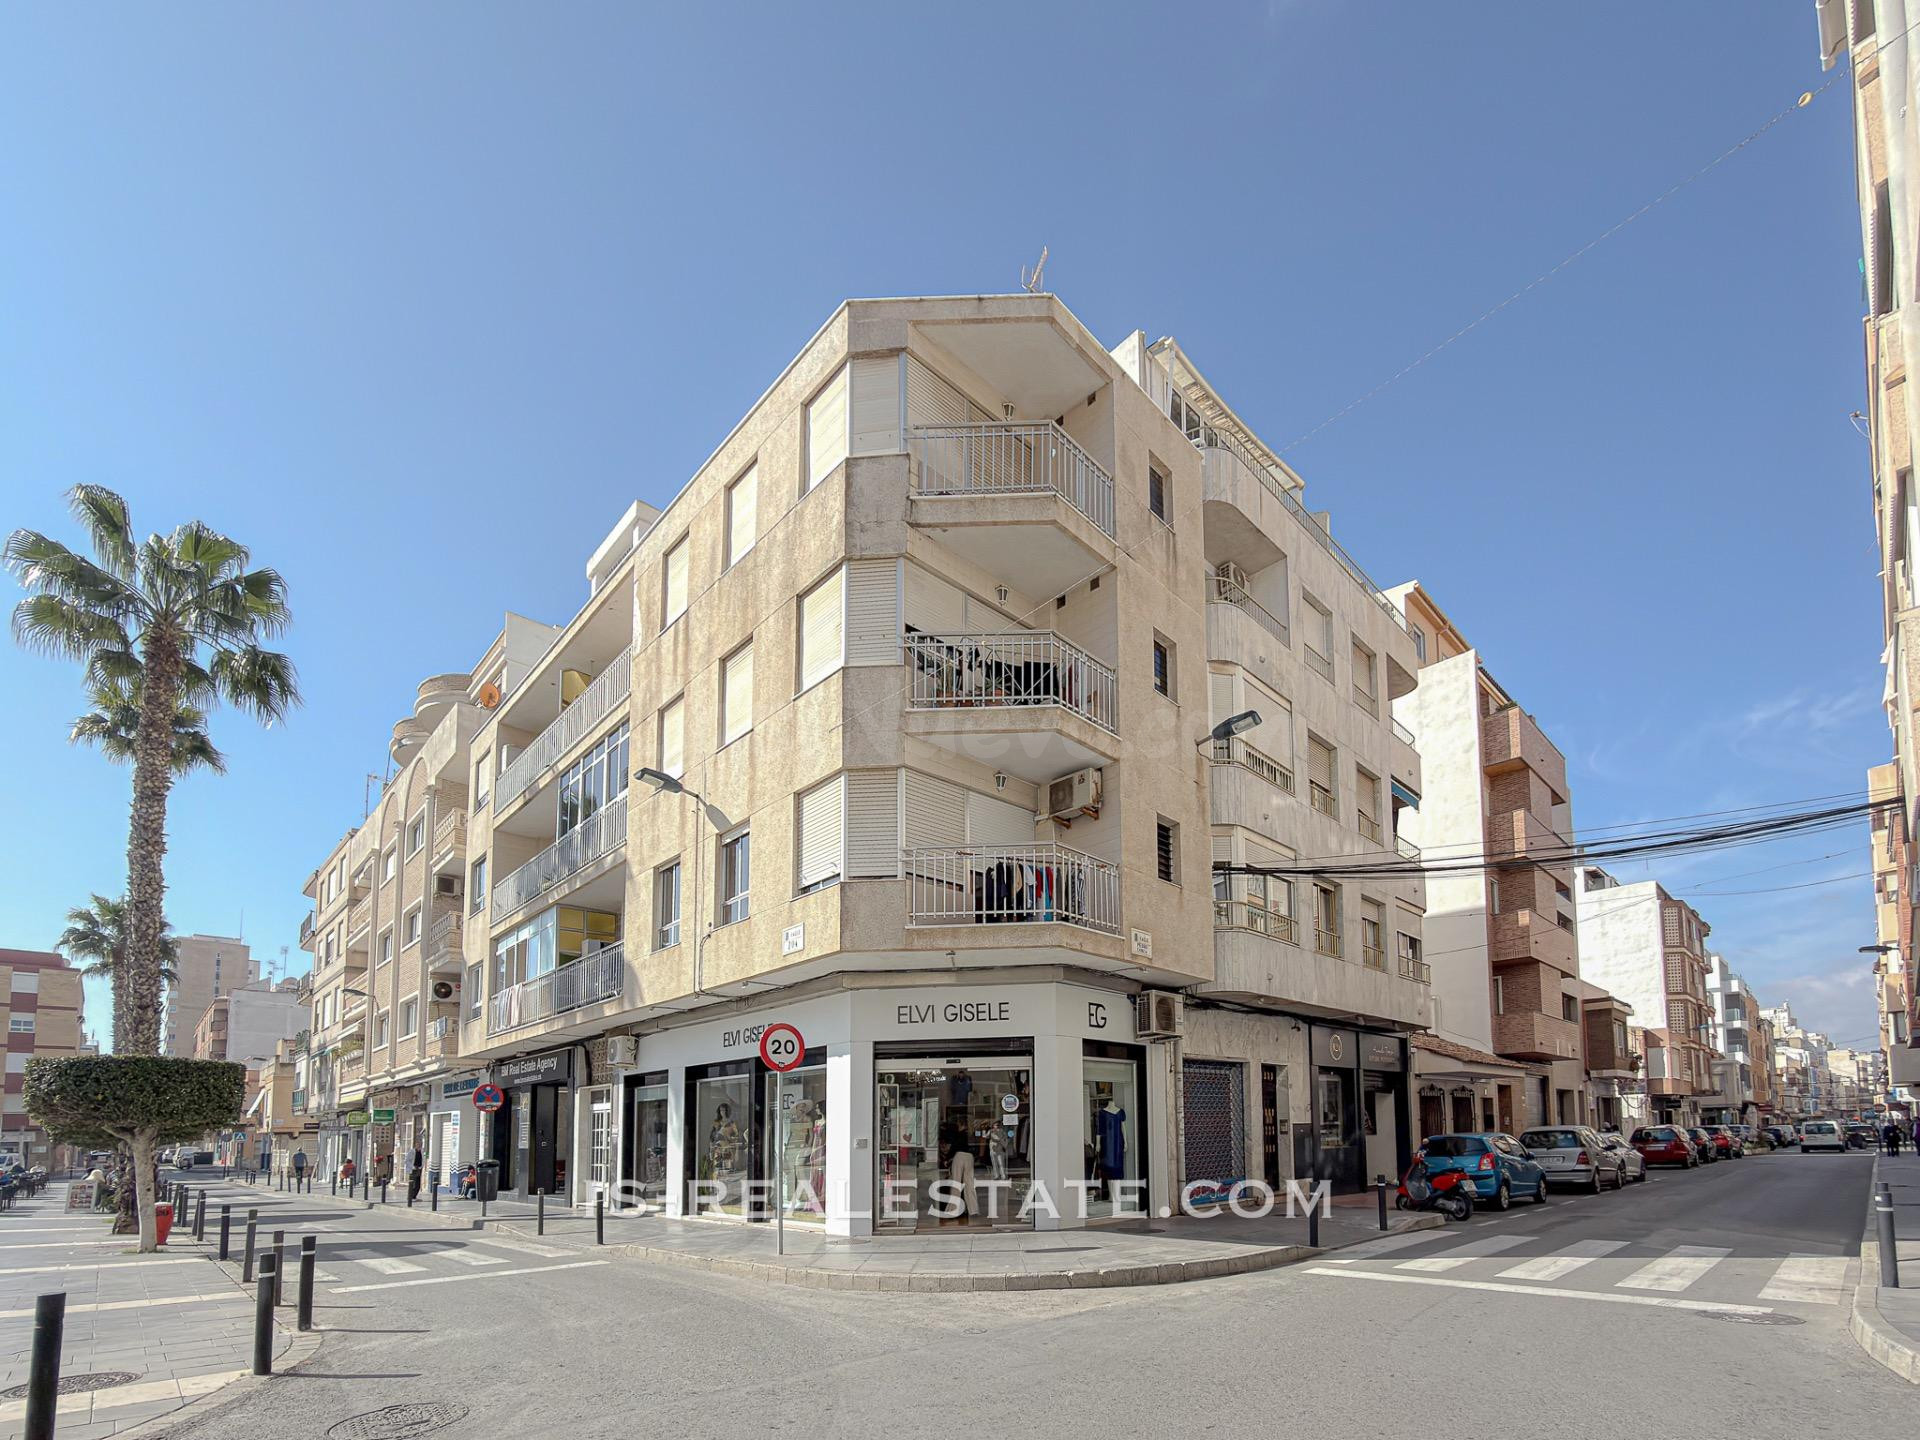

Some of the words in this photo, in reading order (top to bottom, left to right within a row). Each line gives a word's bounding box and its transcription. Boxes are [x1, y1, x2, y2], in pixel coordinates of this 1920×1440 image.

[897, 1005, 936, 1024] ELVI
[944, 1002, 1010, 1022] GISELE
[1087, 1002, 1108, 1028] EG
[723, 1030, 741, 1047] ELVI
[743, 1023, 774, 1044] GISE
[771, 1039, 796, 1055] 20
[509, 1062, 520, 1075] Real
[520, 1060, 536, 1073] Estate
[536, 1057, 558, 1072] Agency
